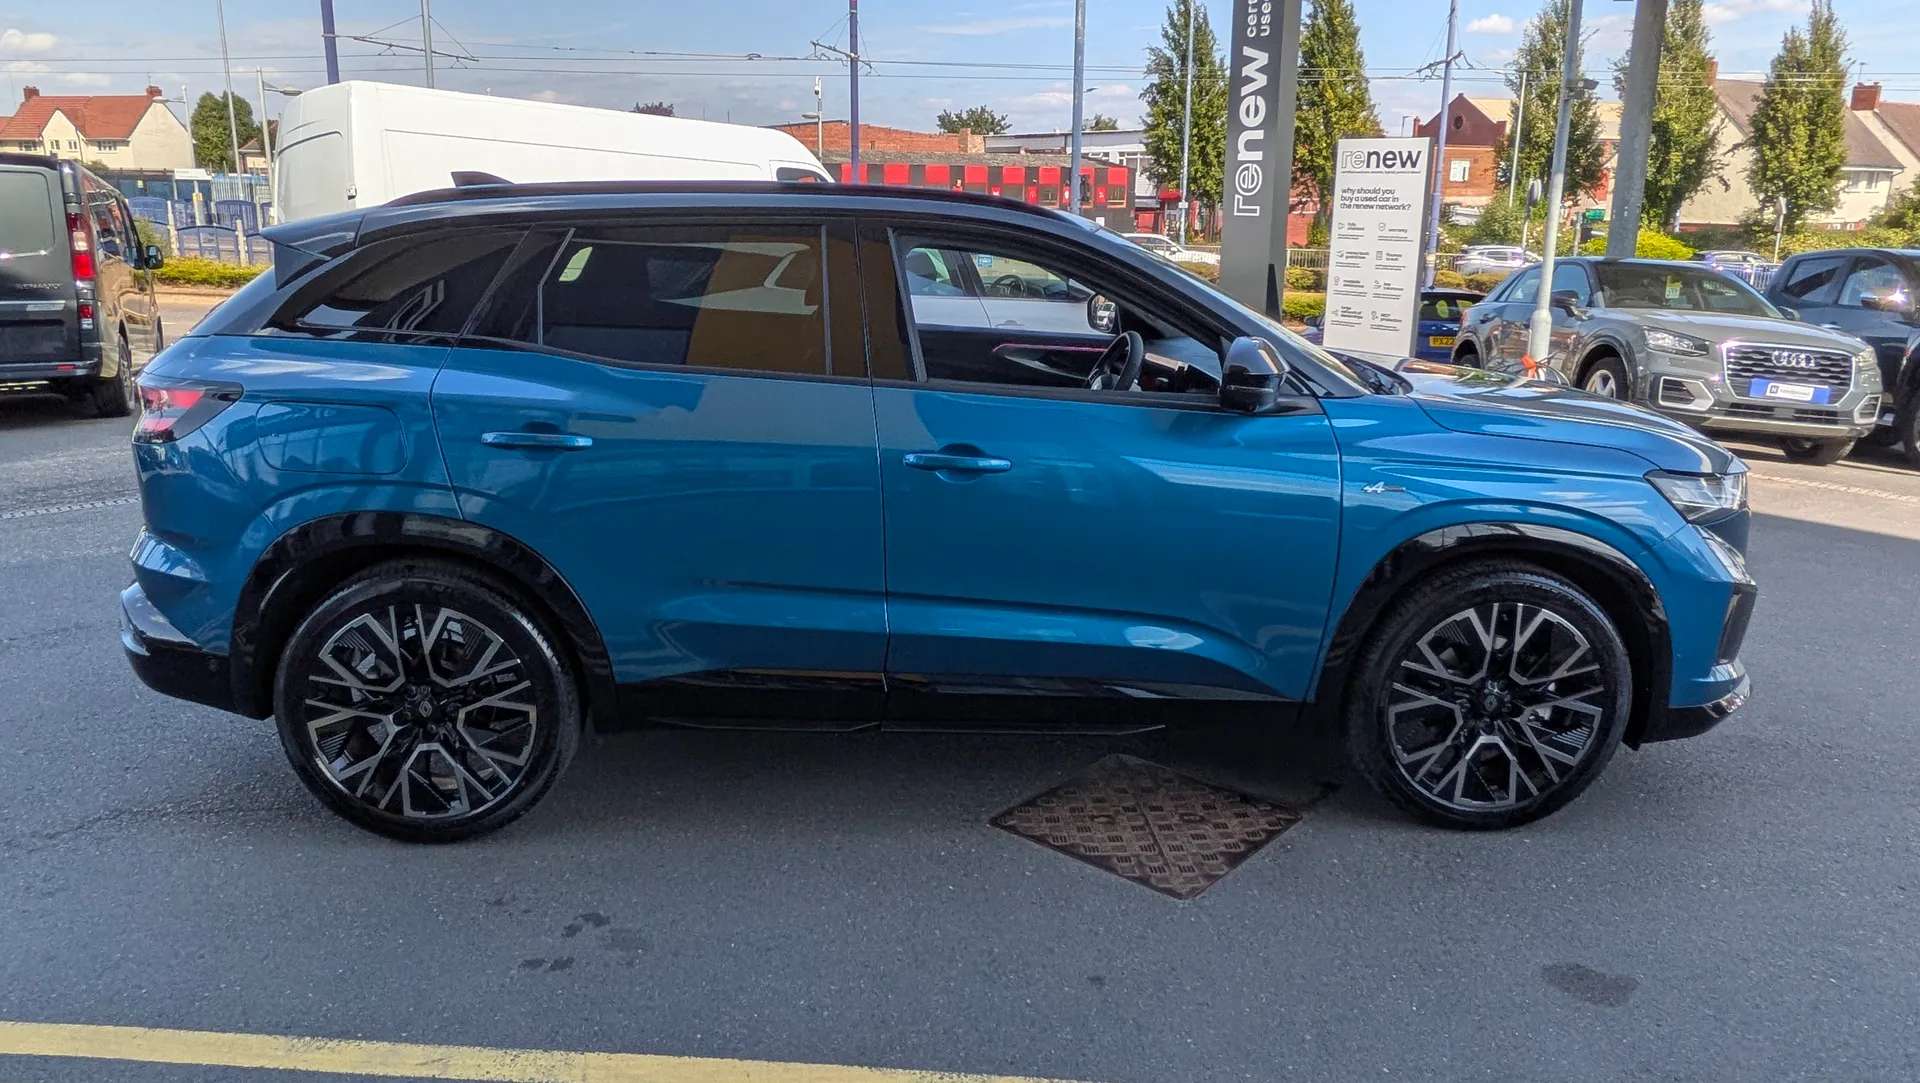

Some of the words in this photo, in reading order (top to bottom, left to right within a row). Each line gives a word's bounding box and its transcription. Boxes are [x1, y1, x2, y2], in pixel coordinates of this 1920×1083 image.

[1260, 0, 1271, 37] use
[1233, 46, 1269, 216] renew
[1341, 150, 1422, 169] renew
[1341, 187, 1355, 196] why
[1356, 187, 1381, 195] should
[1382, 188, 1396, 196] you
[1340, 195, 1354, 203] buy
[1391, 195, 1399, 203] in
[1375, 203, 1412, 211] network?
